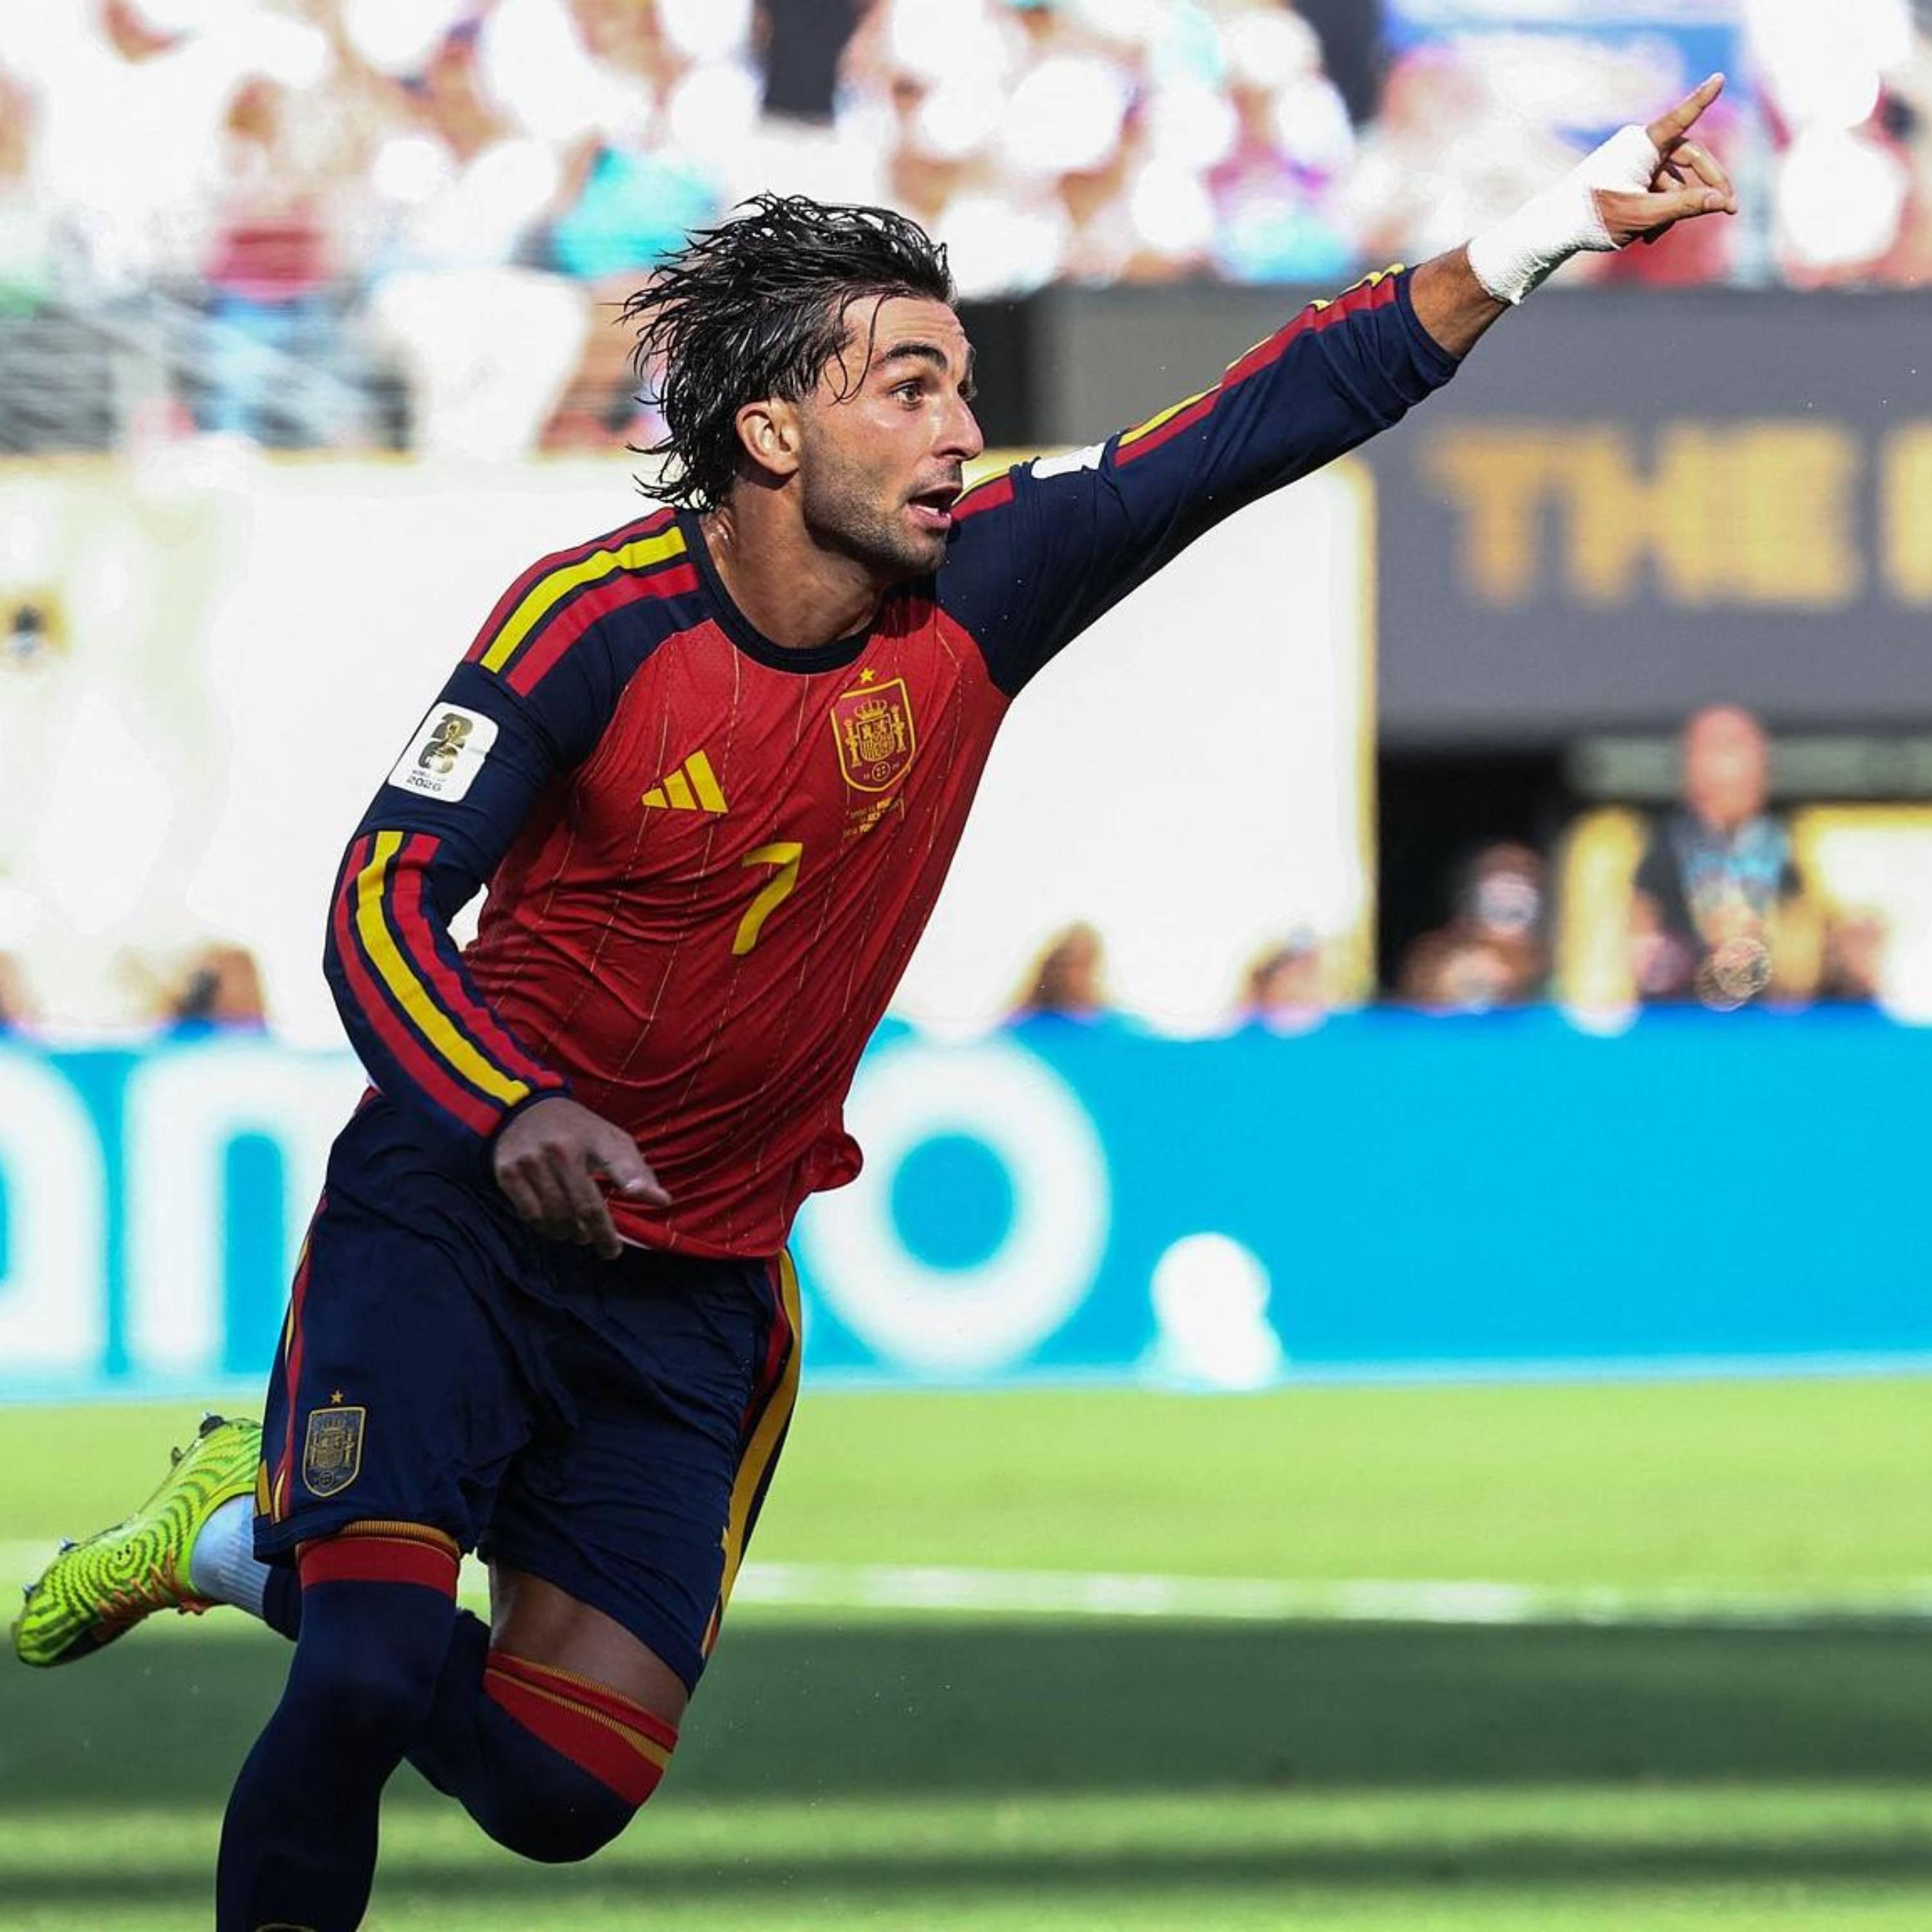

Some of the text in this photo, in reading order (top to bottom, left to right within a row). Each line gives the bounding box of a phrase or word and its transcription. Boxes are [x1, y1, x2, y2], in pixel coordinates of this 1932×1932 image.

[1427, 420, 1858, 605] THE
[406, 775, 442, 792] 2026
[732, 842, 803, 954] 7
